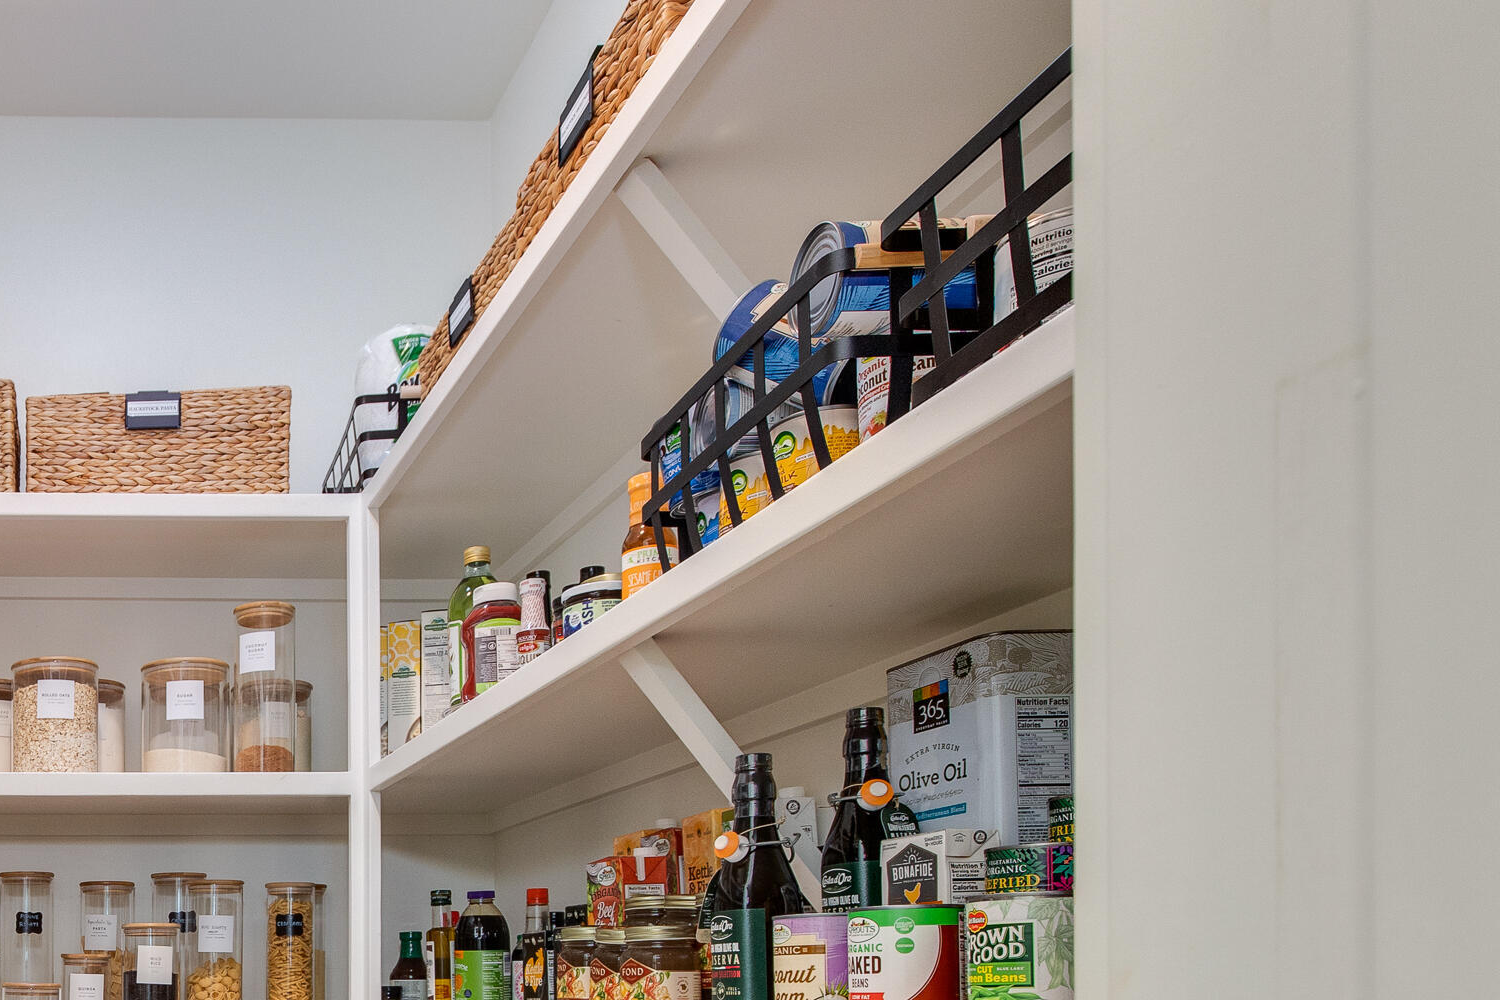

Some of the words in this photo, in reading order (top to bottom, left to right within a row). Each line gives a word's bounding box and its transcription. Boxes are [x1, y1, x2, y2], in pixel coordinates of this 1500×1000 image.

[1016, 698, 1048, 706] Nutrition
[1049, 698, 1069, 706] Facts
[1017, 721, 1041, 729] Calories
[1053, 719, 1069, 728] 120
[904, 746, 930, 765] EXTRA
[932, 743, 961, 752] VIRGIN
[898, 771, 940, 793] Olive
[943, 758, 968, 782] Oil
[891, 862, 934, 882] BONAFIDE
[597, 901, 616, 920] Beef
[972, 942, 1027, 965] GOOD
[621, 967, 644, 977] FOND
[976, 965, 994, 974] CUT
[851, 978, 869, 988] BEANS
[985, 973, 1027, 983] Beans
